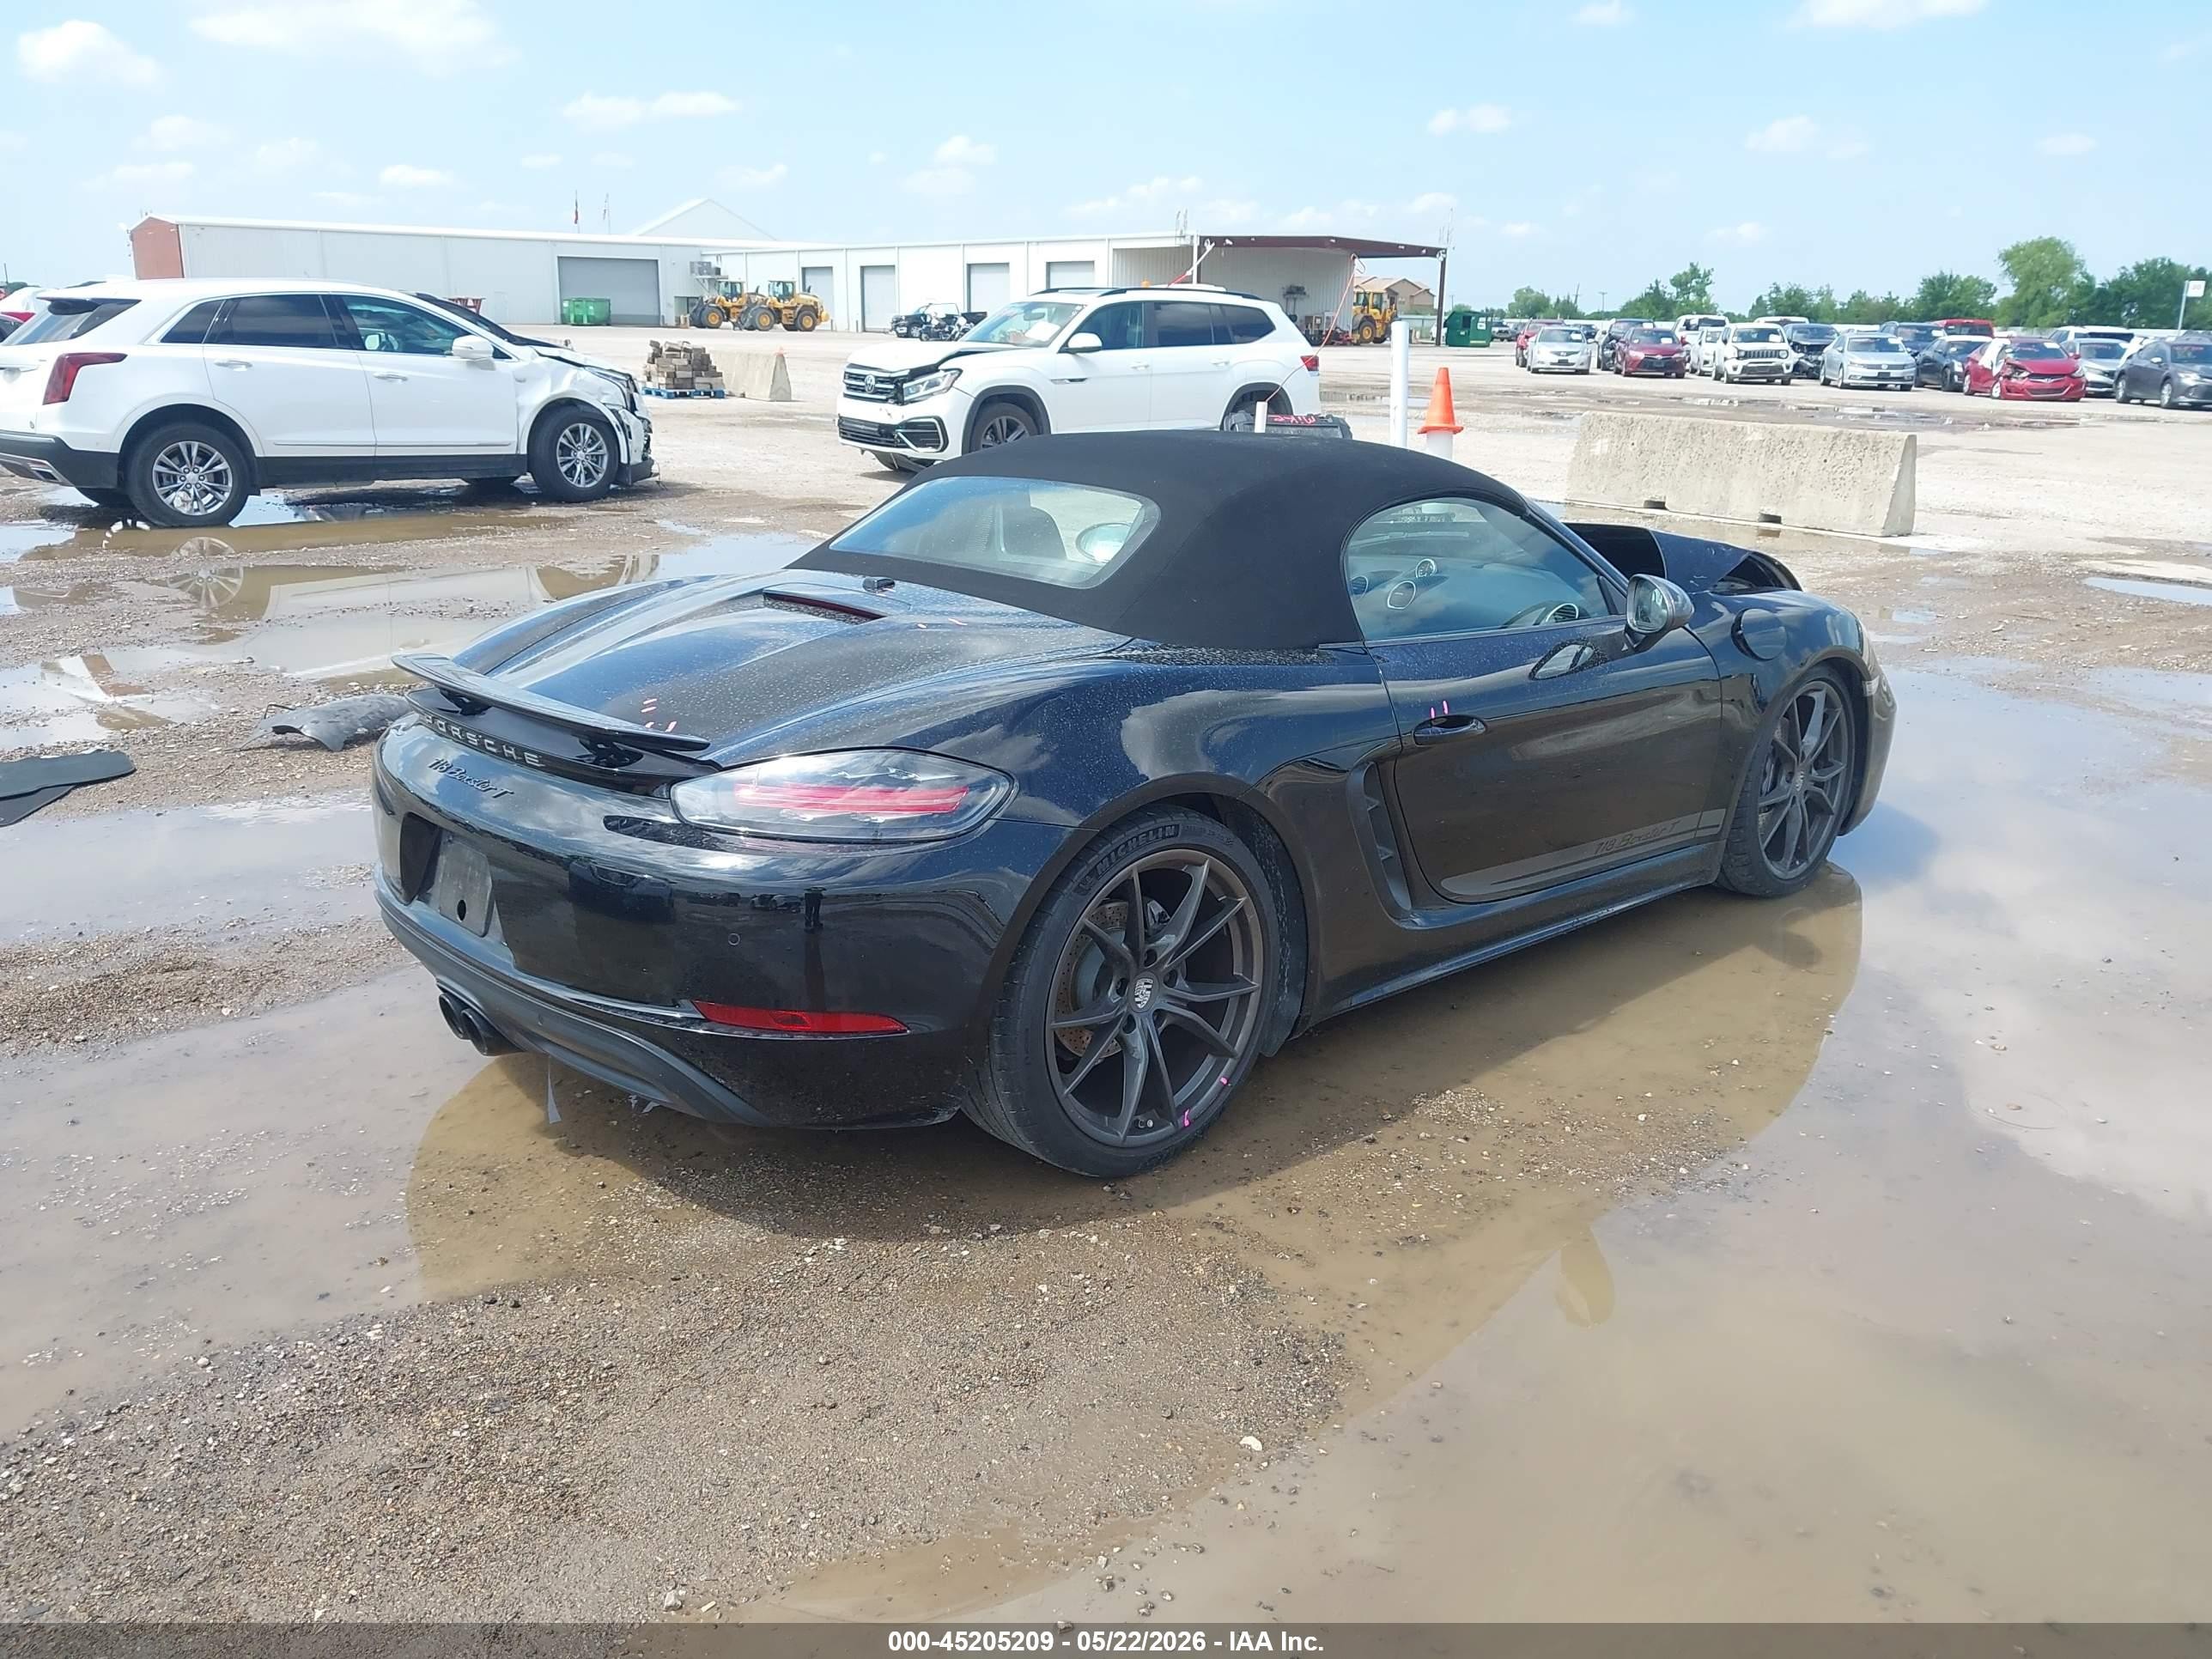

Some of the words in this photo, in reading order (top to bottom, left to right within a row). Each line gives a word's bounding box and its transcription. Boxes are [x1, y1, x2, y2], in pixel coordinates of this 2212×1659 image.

[424, 714, 546, 767] PORSCHE
[428, 757, 453, 774] 718
[492, 788, 515, 799] T
[1096, 824, 1177, 875] MICHELIN
[1595, 838, 1618, 856] 718
